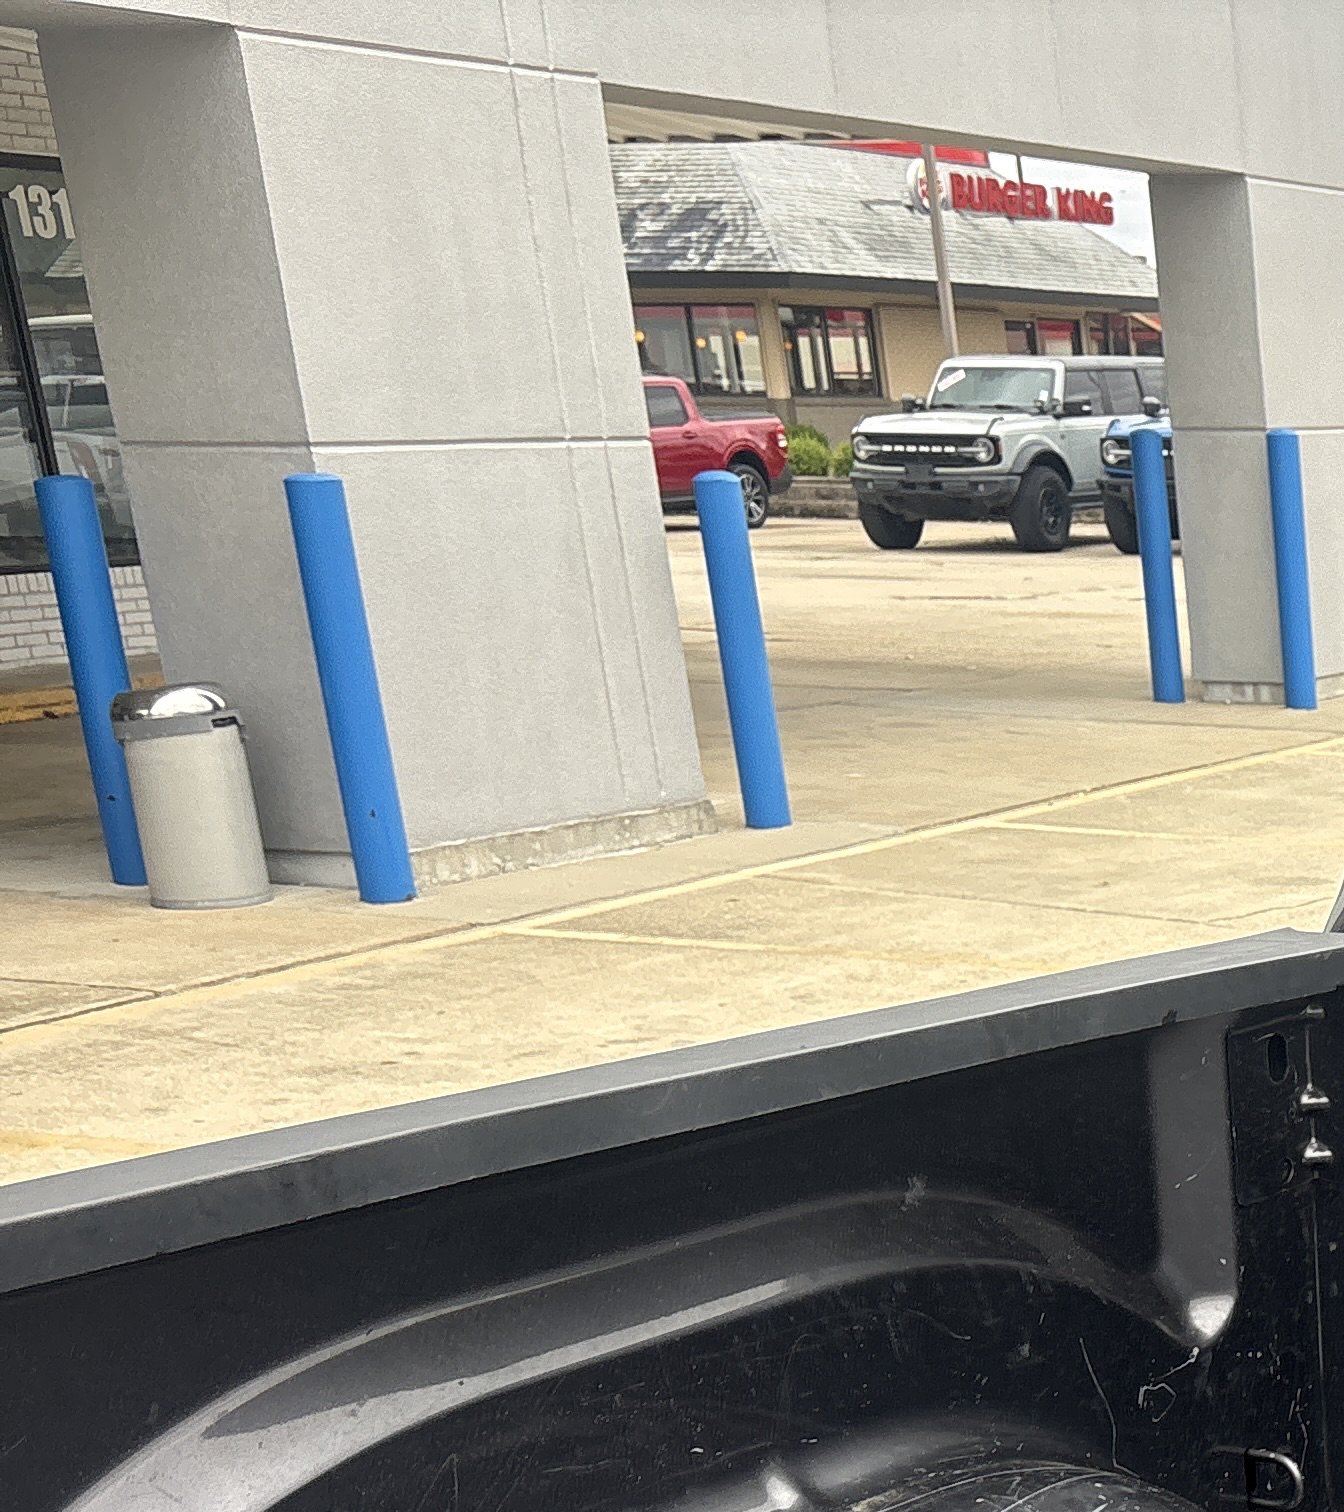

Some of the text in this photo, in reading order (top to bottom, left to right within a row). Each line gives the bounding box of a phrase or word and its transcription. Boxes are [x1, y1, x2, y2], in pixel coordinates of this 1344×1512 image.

[8, 184, 76, 239] 131
[950, 172, 1050, 219] BURGER
[1051, 186, 1114, 225] KING
